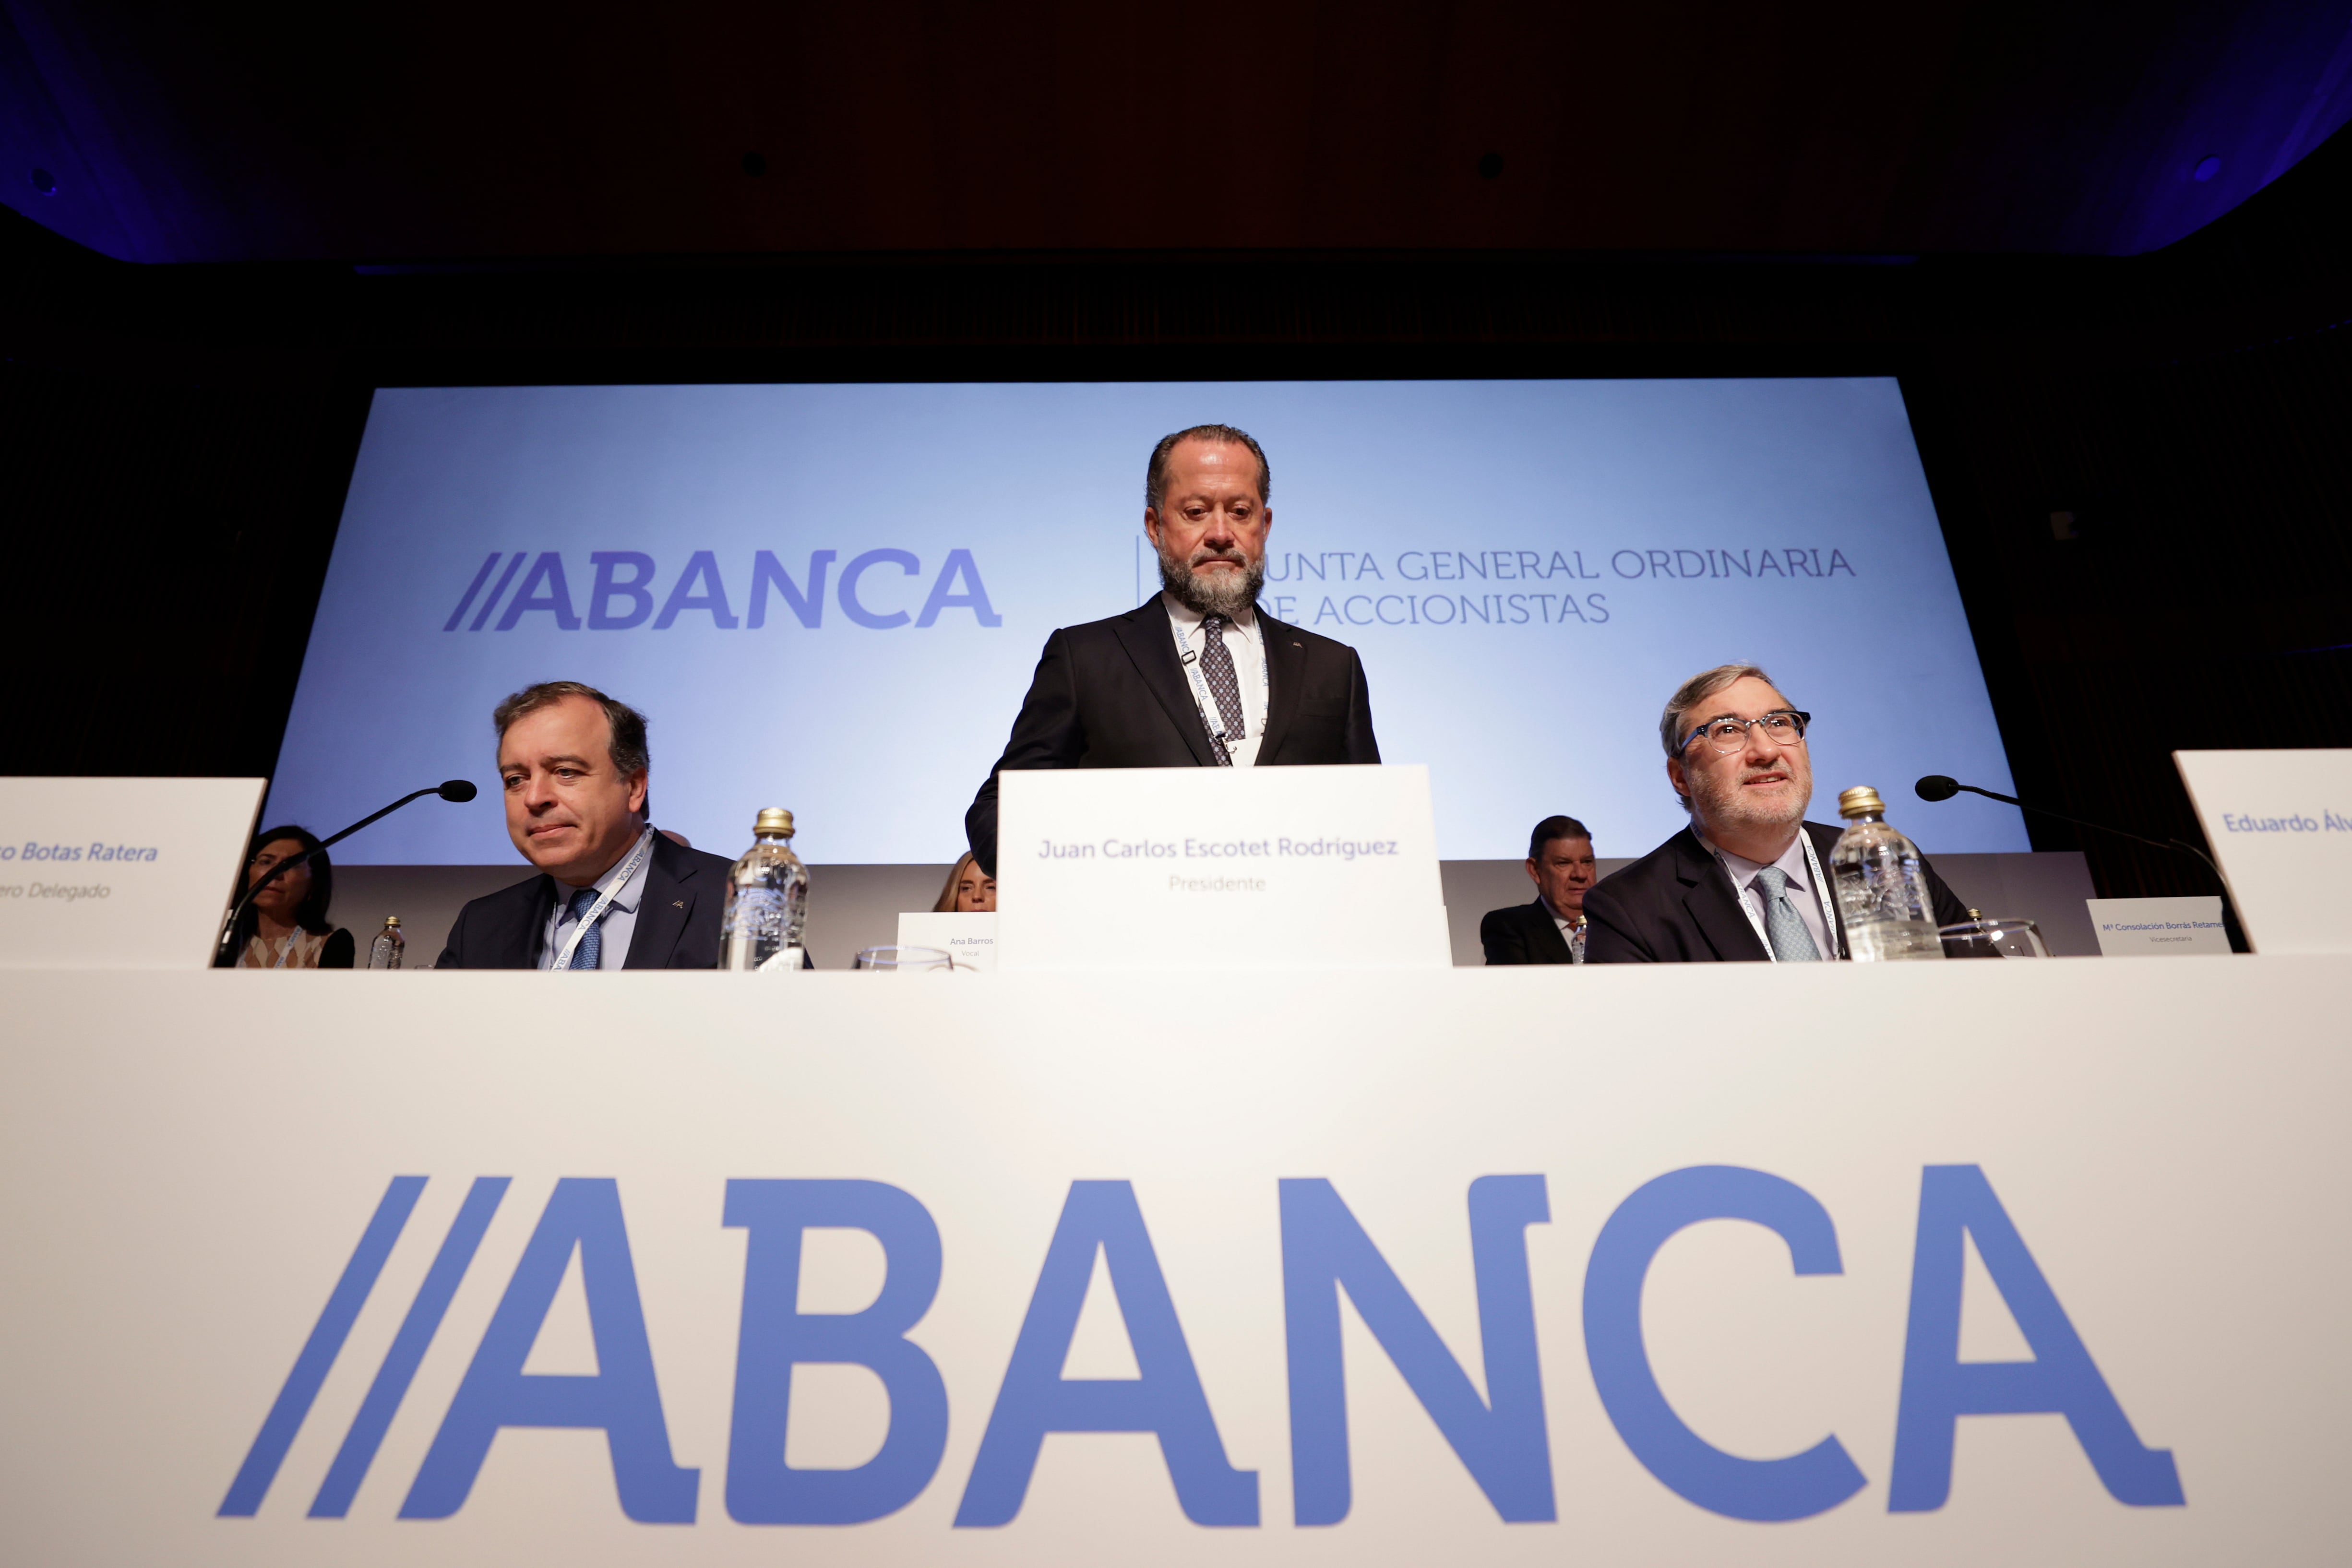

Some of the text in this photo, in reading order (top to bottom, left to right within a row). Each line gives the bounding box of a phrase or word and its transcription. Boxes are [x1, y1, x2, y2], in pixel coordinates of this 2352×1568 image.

[1265, 548, 1857, 582] UNTA GENERAL ORDINARIA
[1313, 593, 1610, 625] ACCIONISTAS
[2222, 814, 2319, 832] Eduardo
[0, 842, 158, 861] o Botas Ratera
[1039, 837, 1399, 860] Juan Carlos Escotet Rodríguez
[28, 881, 111, 903] Delegado
[1169, 874, 1266, 892] Presidente
[2115, 922, 2165, 931] Consolación
[2165, 922, 2192, 930] Borrás
